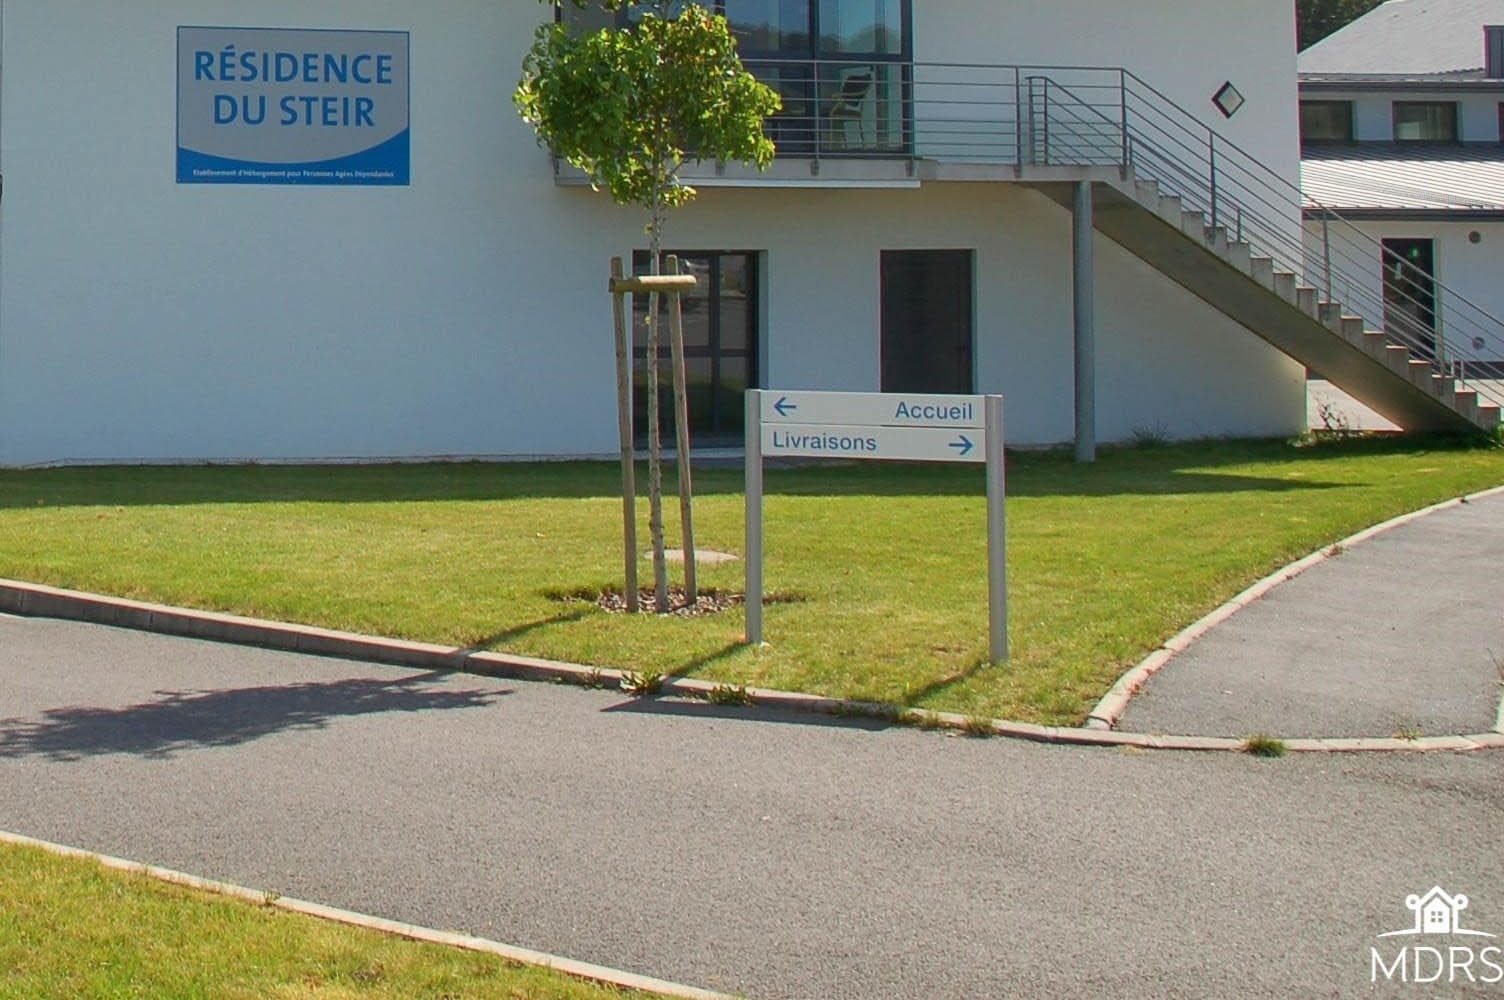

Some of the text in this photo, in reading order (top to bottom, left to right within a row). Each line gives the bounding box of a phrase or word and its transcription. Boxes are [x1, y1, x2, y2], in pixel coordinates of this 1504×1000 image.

[194, 44, 393, 85] RÉSIDENCE
[213, 94, 375, 127] DU STEIR
[895, 400, 973, 420] Accueil
[772, 431, 878, 451] Livraisons
